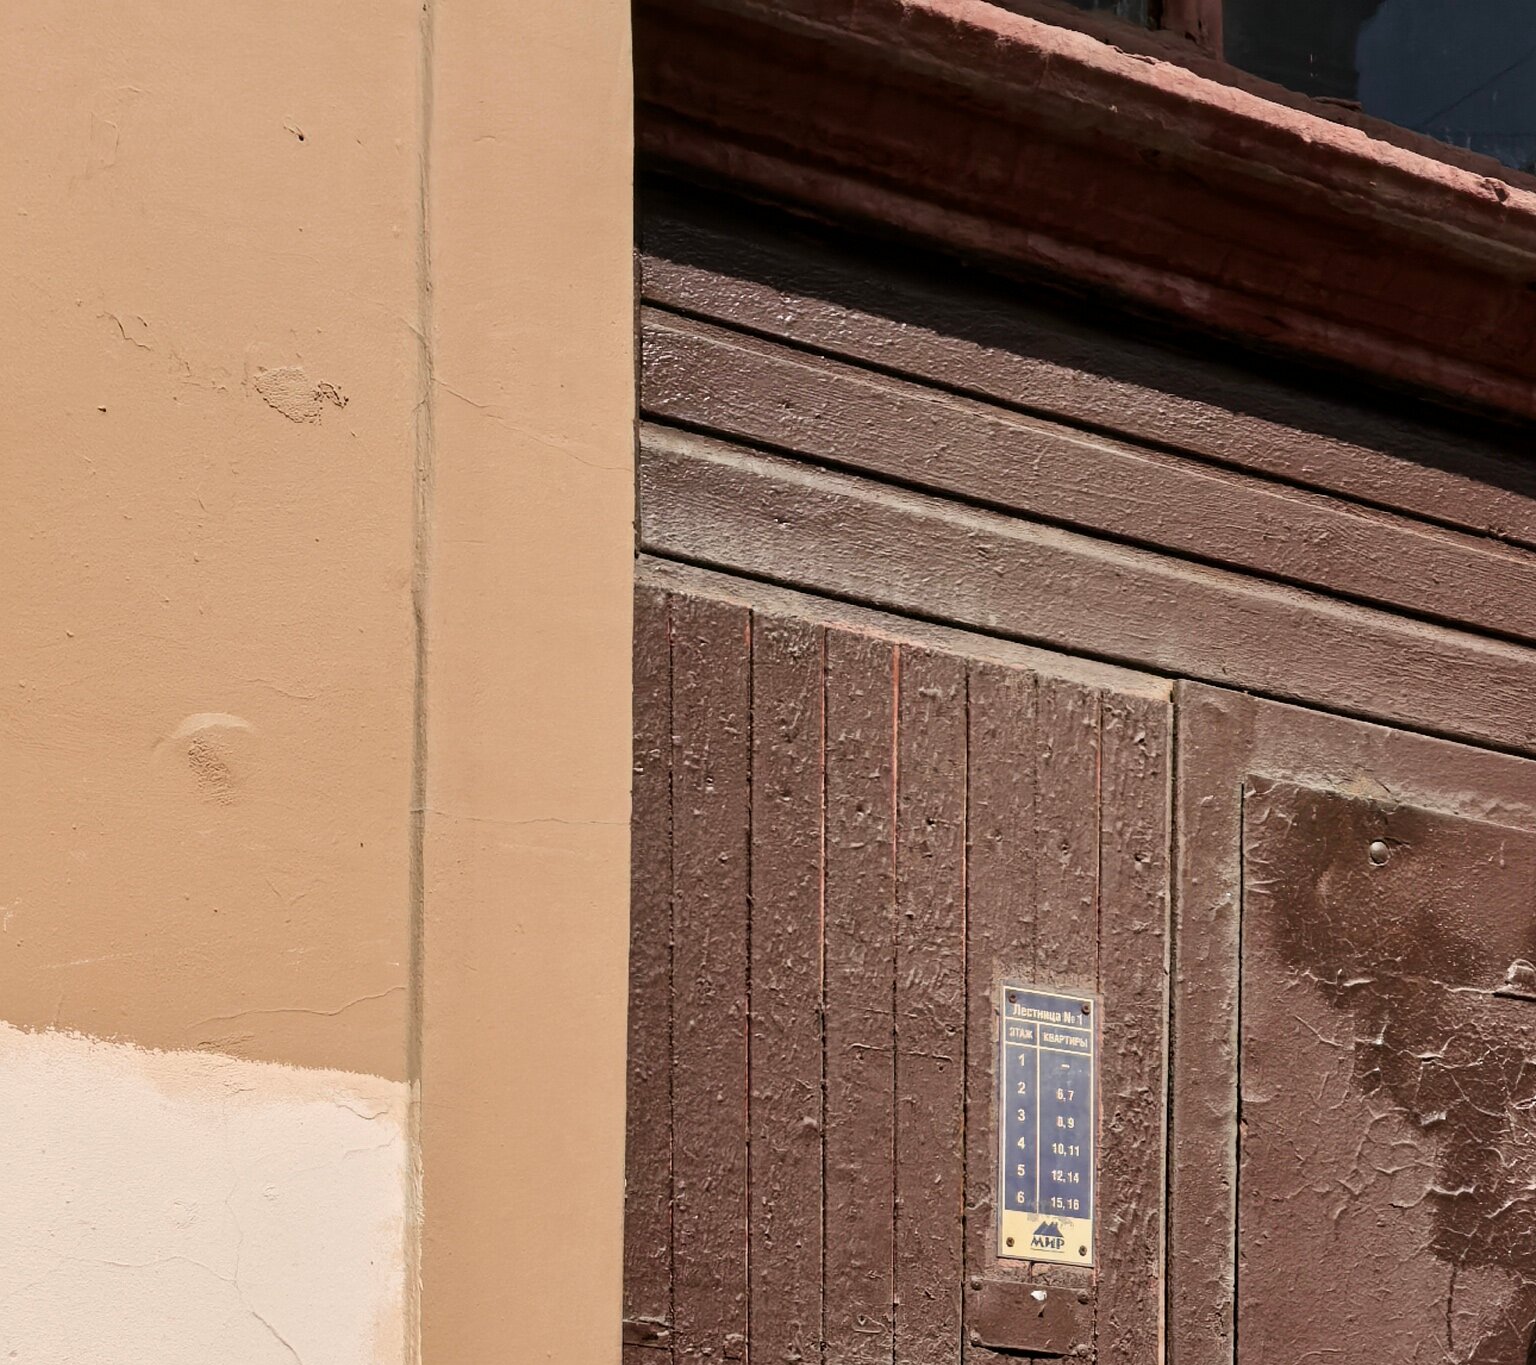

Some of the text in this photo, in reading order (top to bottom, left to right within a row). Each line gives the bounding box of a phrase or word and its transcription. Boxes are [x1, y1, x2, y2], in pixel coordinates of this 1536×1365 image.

[1012, 1003, 1062, 1023] Лестница
[1009, 1026, 1088, 1048] ЭТАЖ КВАРТИРЫ
[1018, 1053, 1025, 1067] 1
[1017, 1081, 1026, 1095] 2
[1017, 1109, 1026, 1122] 3
[1017, 1136, 1026, 1150] 4
[1017, 1164, 1026, 1177] 5
[1016, 1191, 1025, 1204] 6
[1030, 1236, 1065, 1250] МИР
